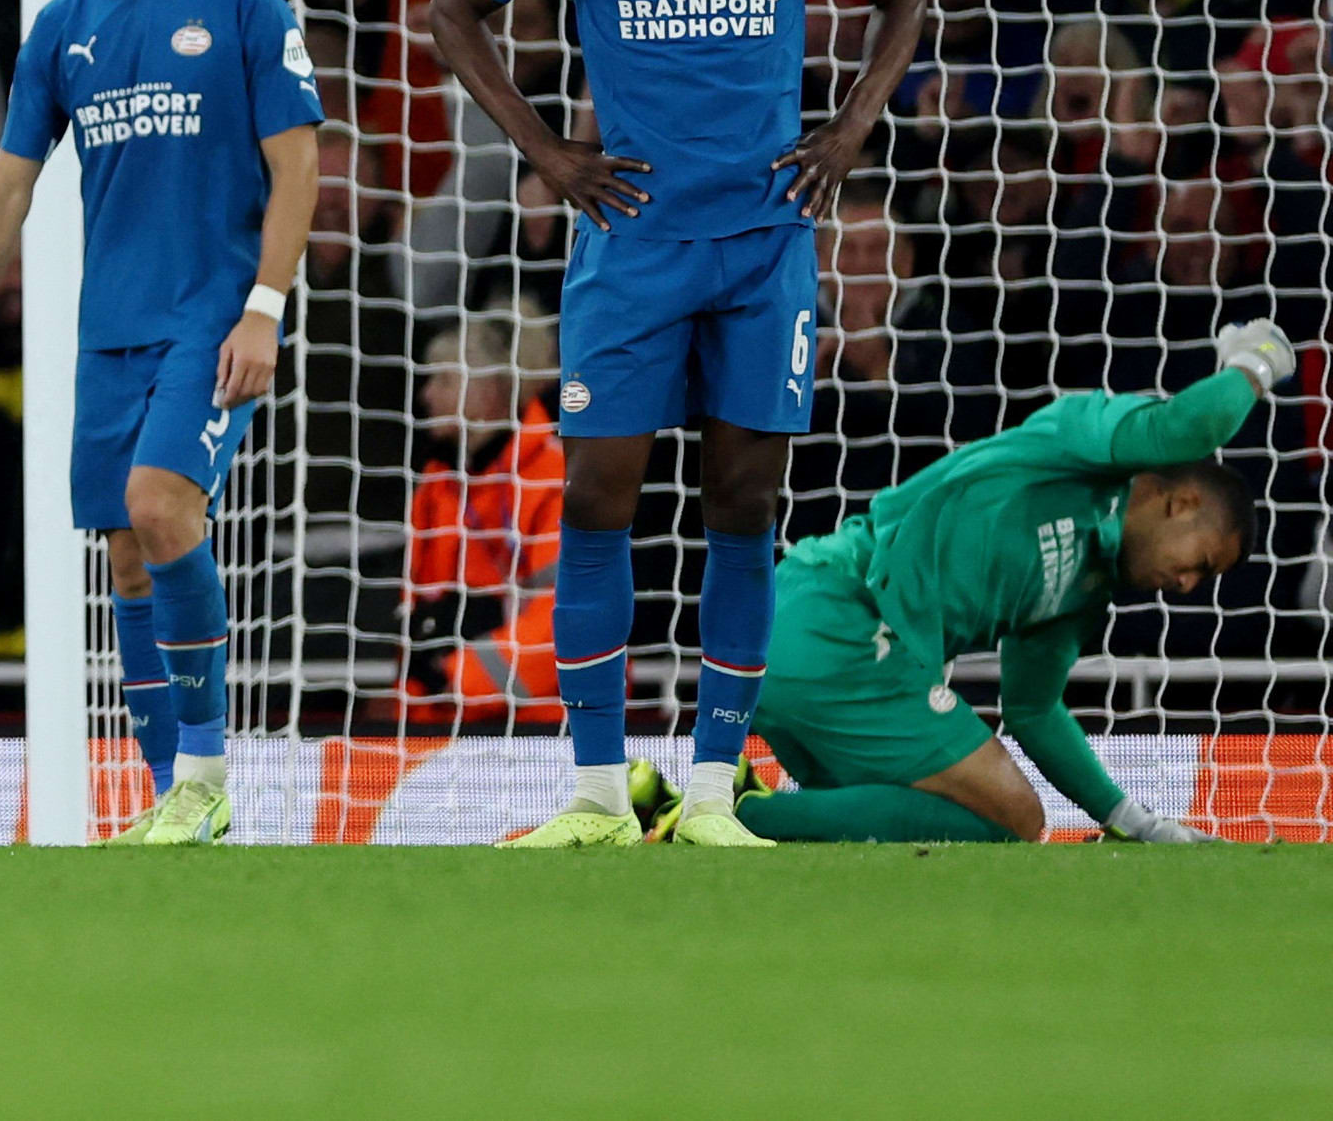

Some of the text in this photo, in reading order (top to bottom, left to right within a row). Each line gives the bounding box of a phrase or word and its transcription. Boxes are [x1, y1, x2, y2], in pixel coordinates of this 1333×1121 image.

[618, 15, 775, 41] EINDHOVEN
[791, 310, 811, 376] 6
[169, 674, 206, 689] PSV
[712, 707, 750, 724] PSV
